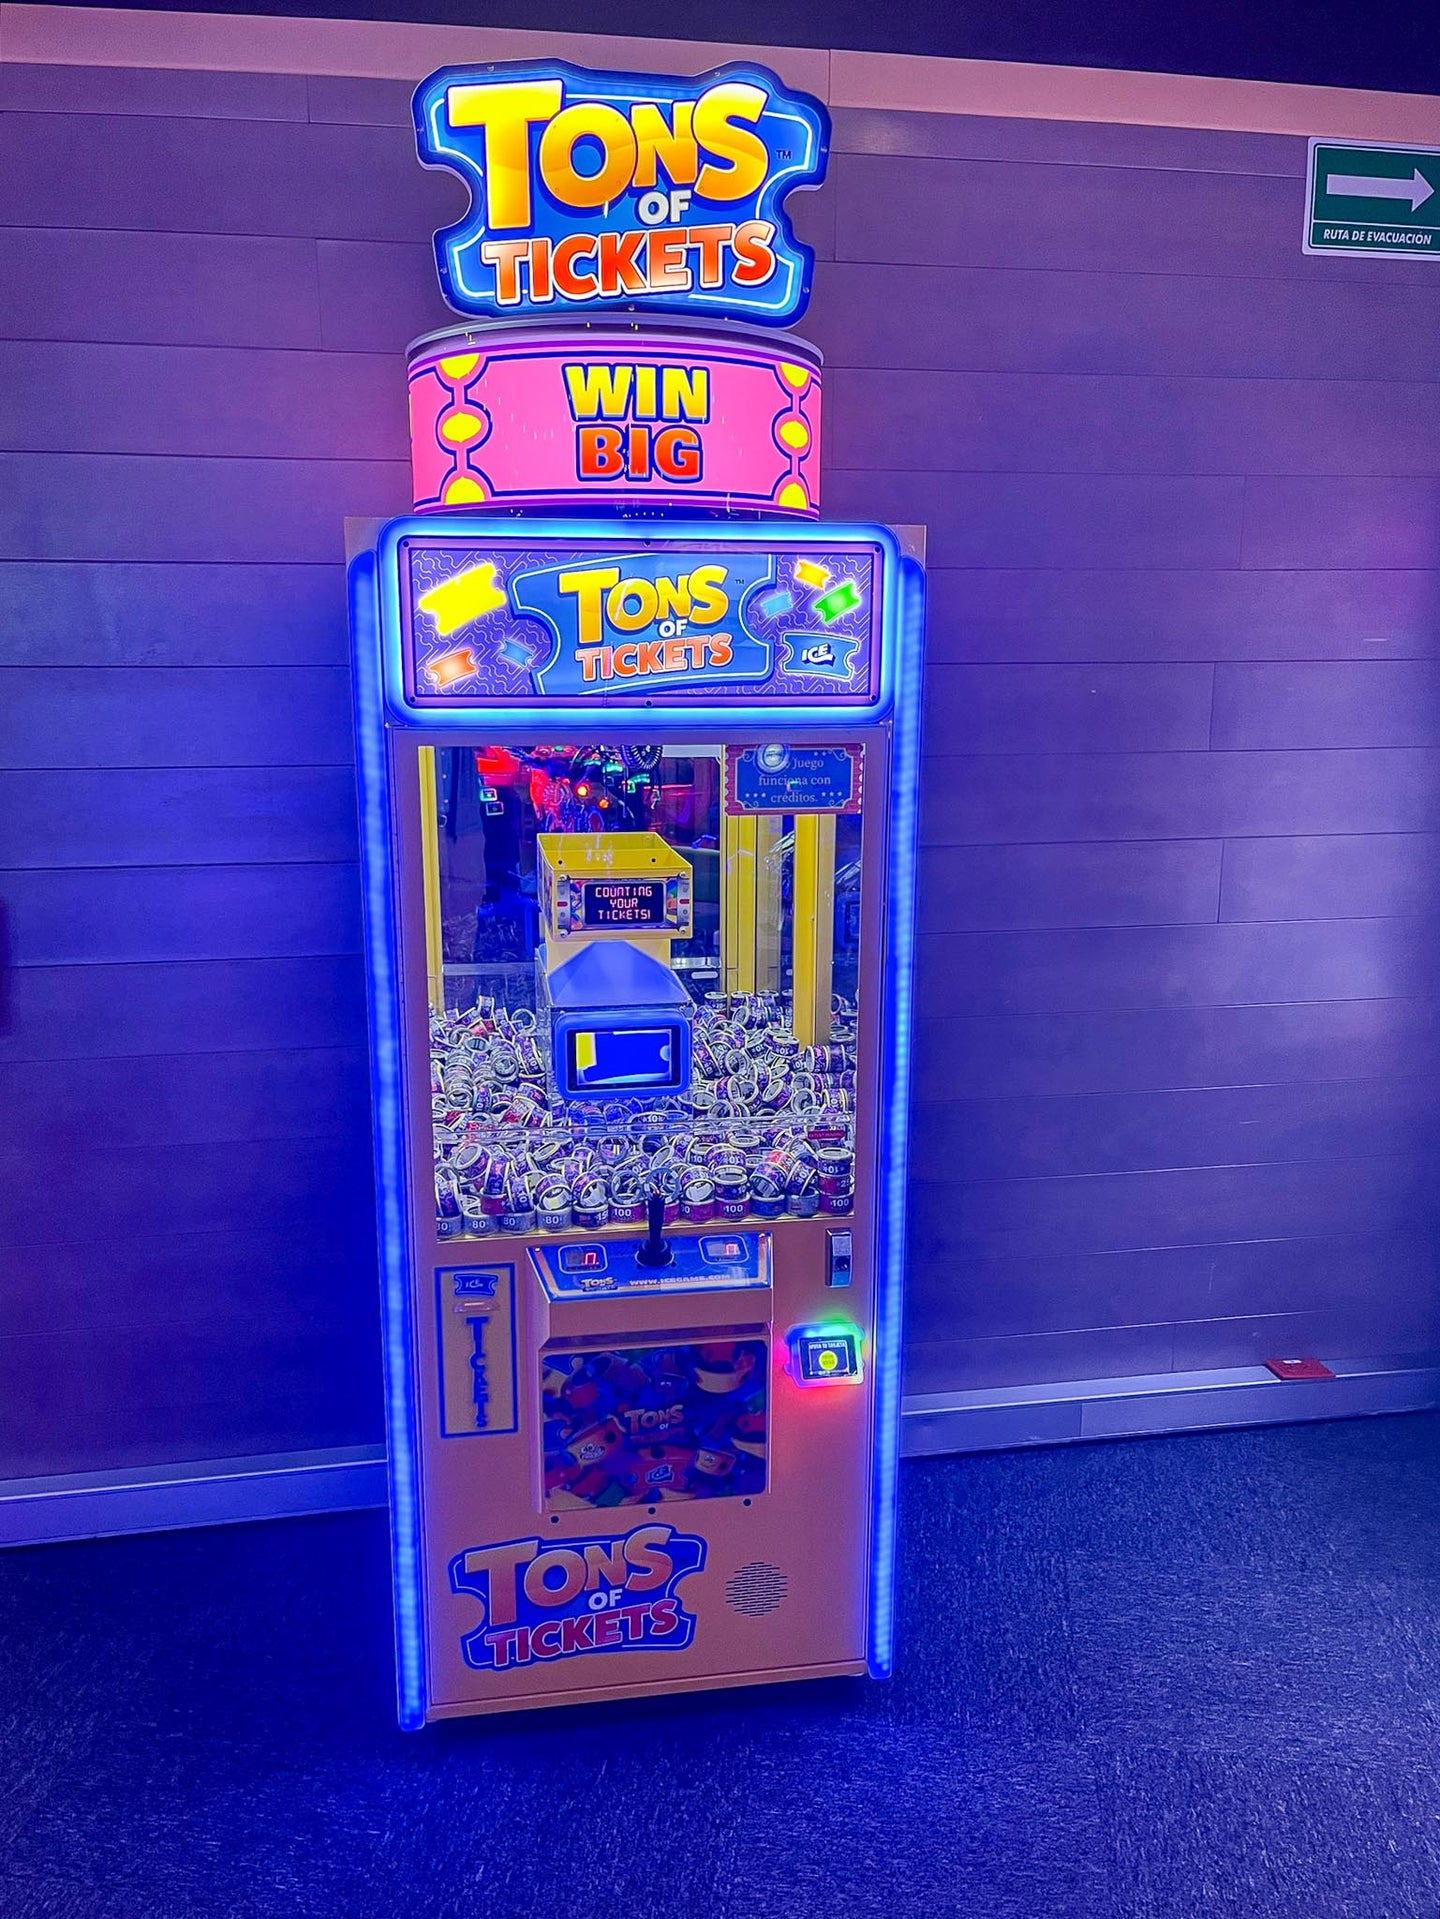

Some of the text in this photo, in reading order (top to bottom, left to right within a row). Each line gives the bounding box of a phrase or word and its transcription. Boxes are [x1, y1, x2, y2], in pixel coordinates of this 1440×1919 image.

[446, 79, 769, 230] TONS
[638, 190, 692, 225] OF
[1323, 229, 1432, 245] RUTA DE EVACUACIÓN
[482, 219, 777, 305] TICKETS
[563, 364, 710, 422] WIN
[576, 425, 702, 482] BIG
[558, 564, 729, 643] TONS
[659, 619, 686, 639] OF
[575, 633, 733, 683] TICKETS
[801, 643, 834, 664] ICE
[810, 776, 831, 786] con
[595, 886, 652, 898] COUNTING
[610, 898, 638, 909] YOUR
[613, 1208, 632, 1218] 100
[724, 1204, 744, 1213] 100
[832, 1198, 850, 1207] 100
[472, 1220, 486, 1229] 80
[545, 1215, 559, 1225] 80
[624, 1404, 684, 1434] TONS
[465, 1526, 673, 1625] TONS
[588, 1589, 622, 1611] OF
[485, 1599, 678, 1667] TICKETS
